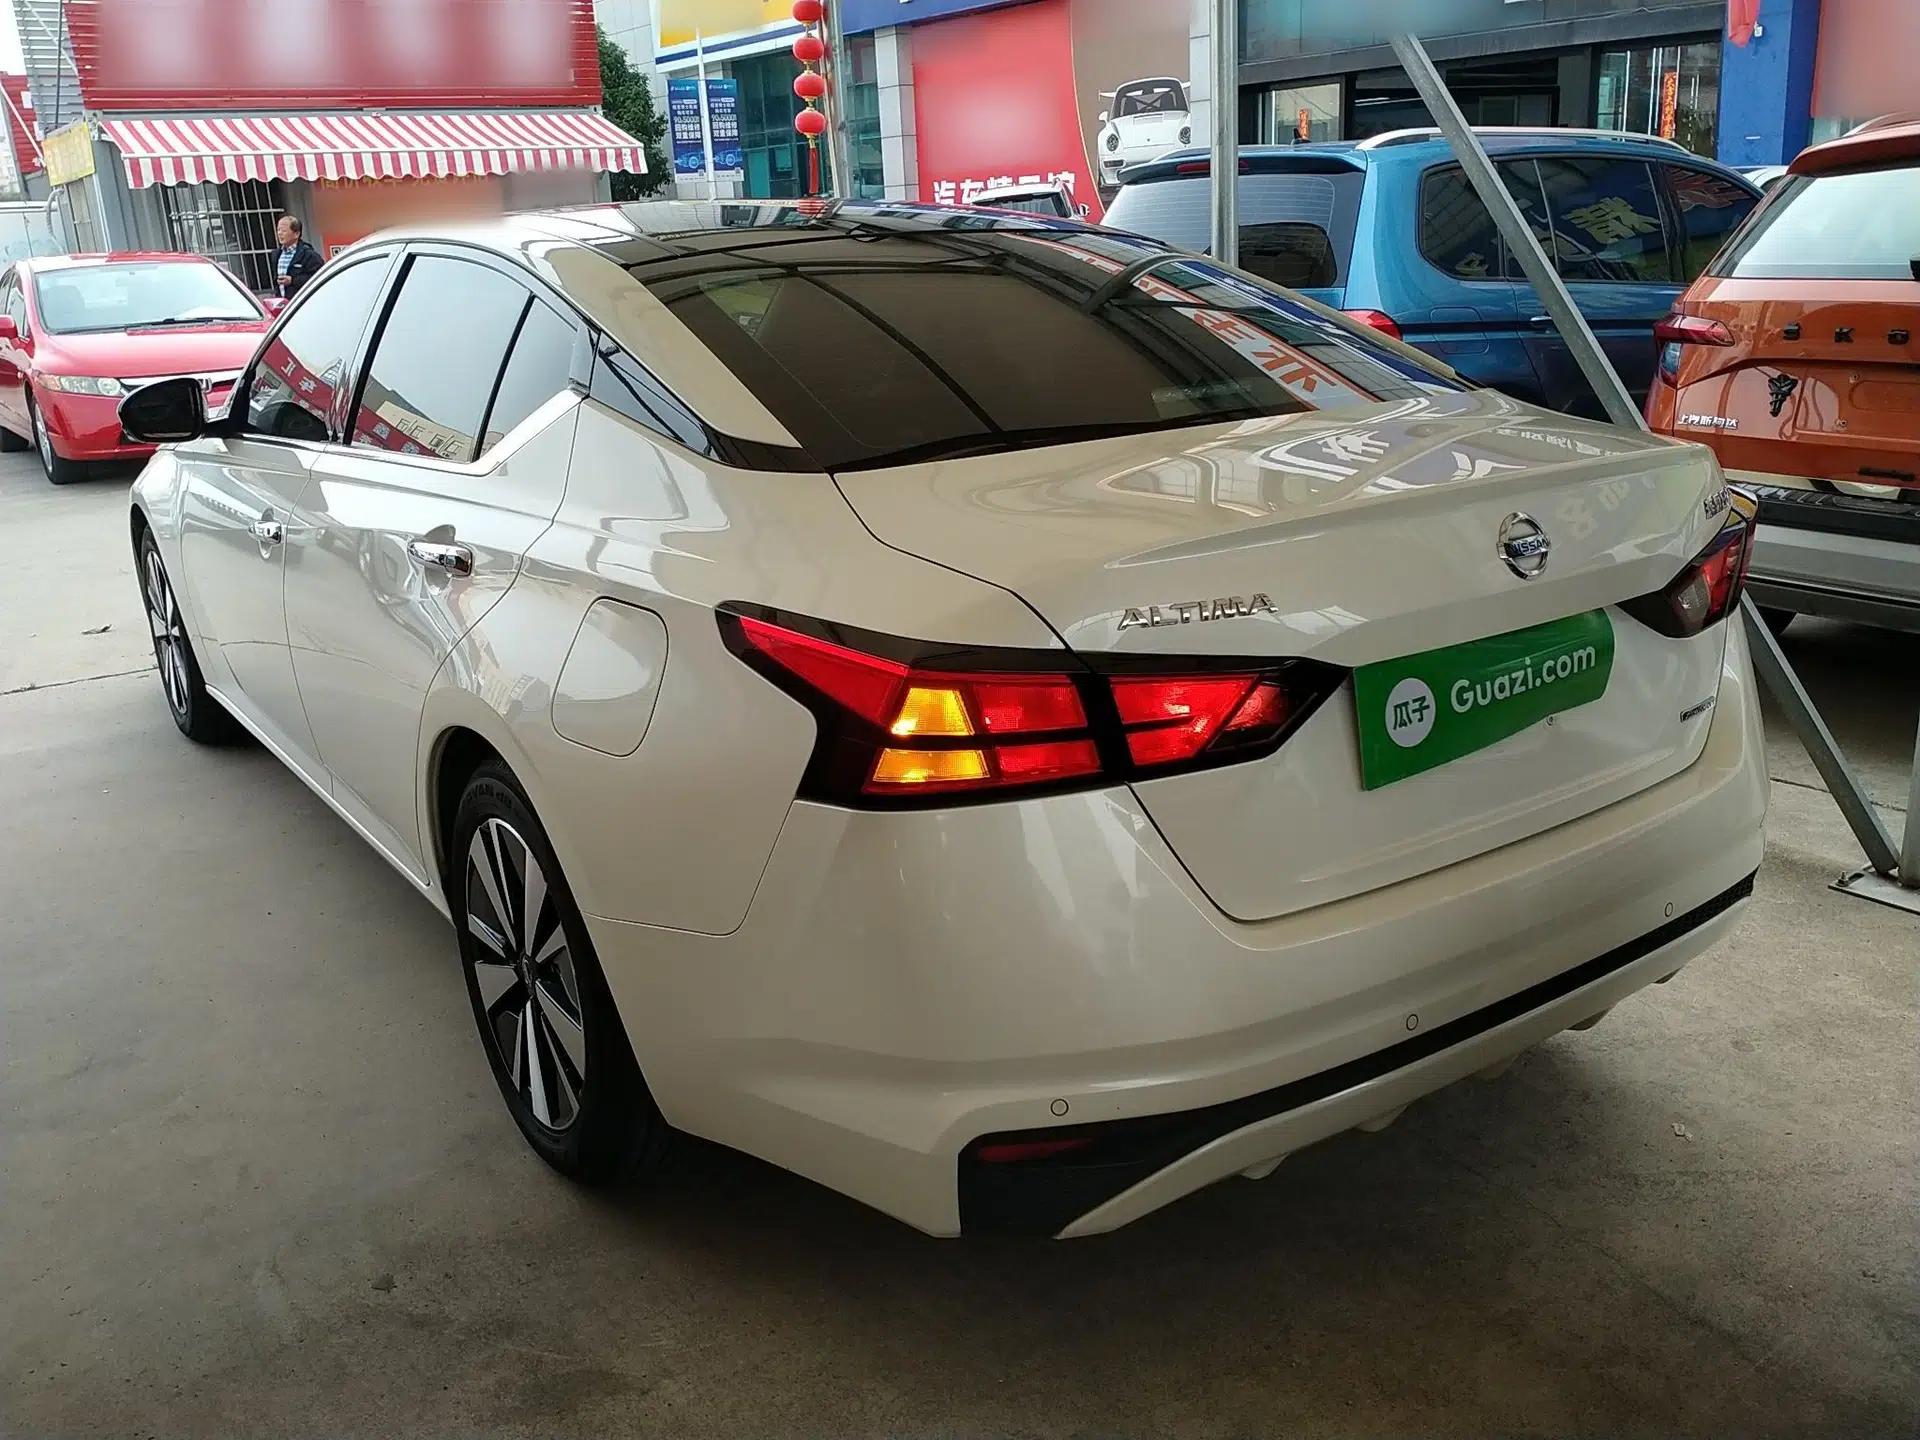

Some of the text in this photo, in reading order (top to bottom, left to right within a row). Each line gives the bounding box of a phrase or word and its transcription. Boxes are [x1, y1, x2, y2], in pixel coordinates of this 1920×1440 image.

[1678, 414, 1739, 430] 上汽斯柯达
[1511, 537, 1549, 556] NISSAN
[1117, 593, 1279, 631] ALTIMA
[1450, 645, 1596, 714] Guazi.com
[1392, 695, 1431, 730] 瓜子
